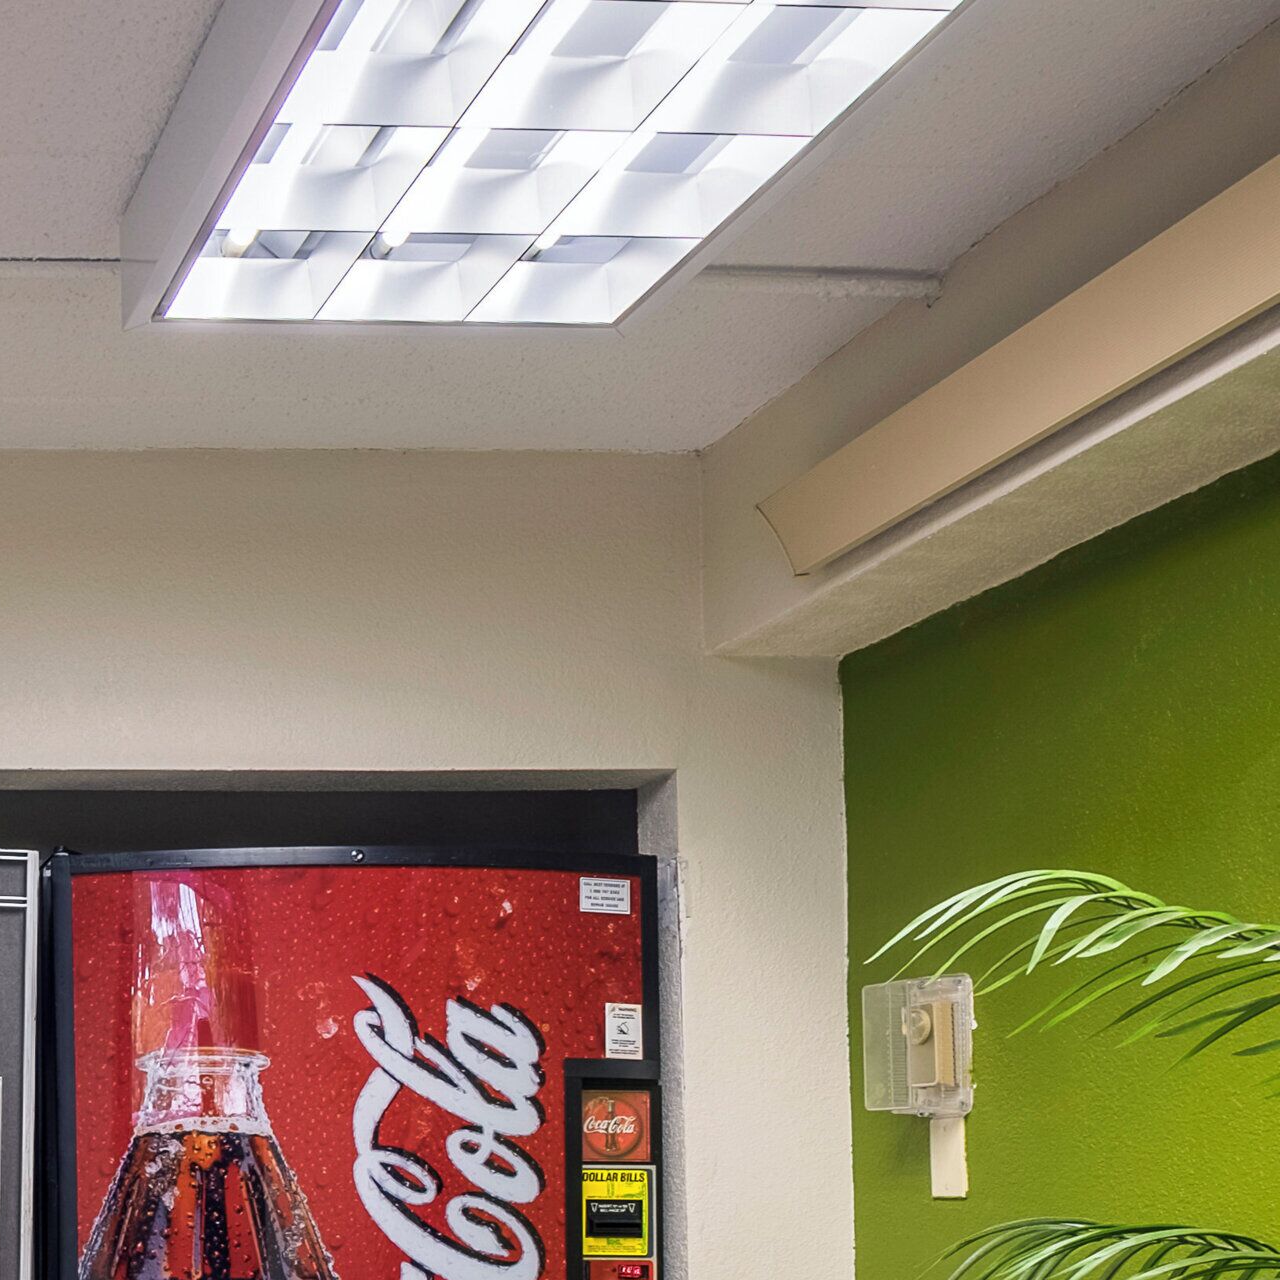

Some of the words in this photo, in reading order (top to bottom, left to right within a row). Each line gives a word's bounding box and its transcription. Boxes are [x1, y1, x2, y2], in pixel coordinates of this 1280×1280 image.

[583, 1114, 637, 1135] Coca-Cola
[582, 1172, 619, 1182] DOLLAR
[620, 1173, 646, 1183] BILLS
